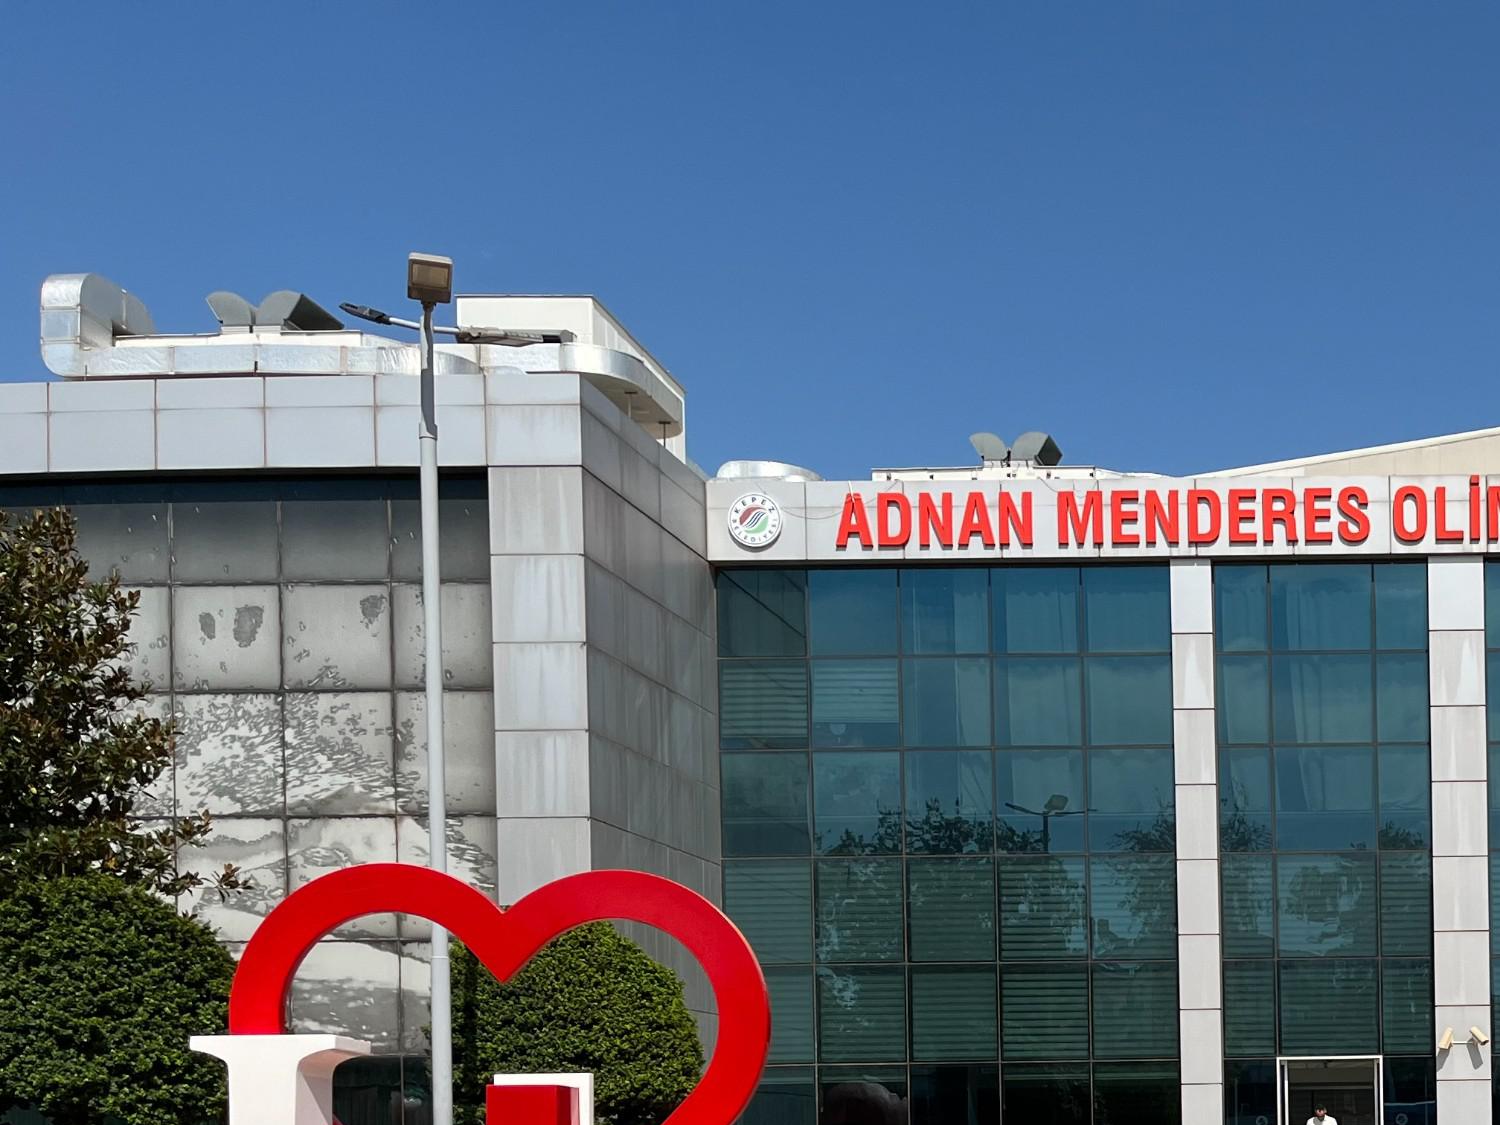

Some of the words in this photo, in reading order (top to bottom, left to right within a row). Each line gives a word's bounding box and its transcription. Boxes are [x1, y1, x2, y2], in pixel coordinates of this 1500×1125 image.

[733, 496, 776, 514] KEPEZ
[836, 492, 1033, 551] ADNAN
[1057, 488, 1371, 549] MENDERES
